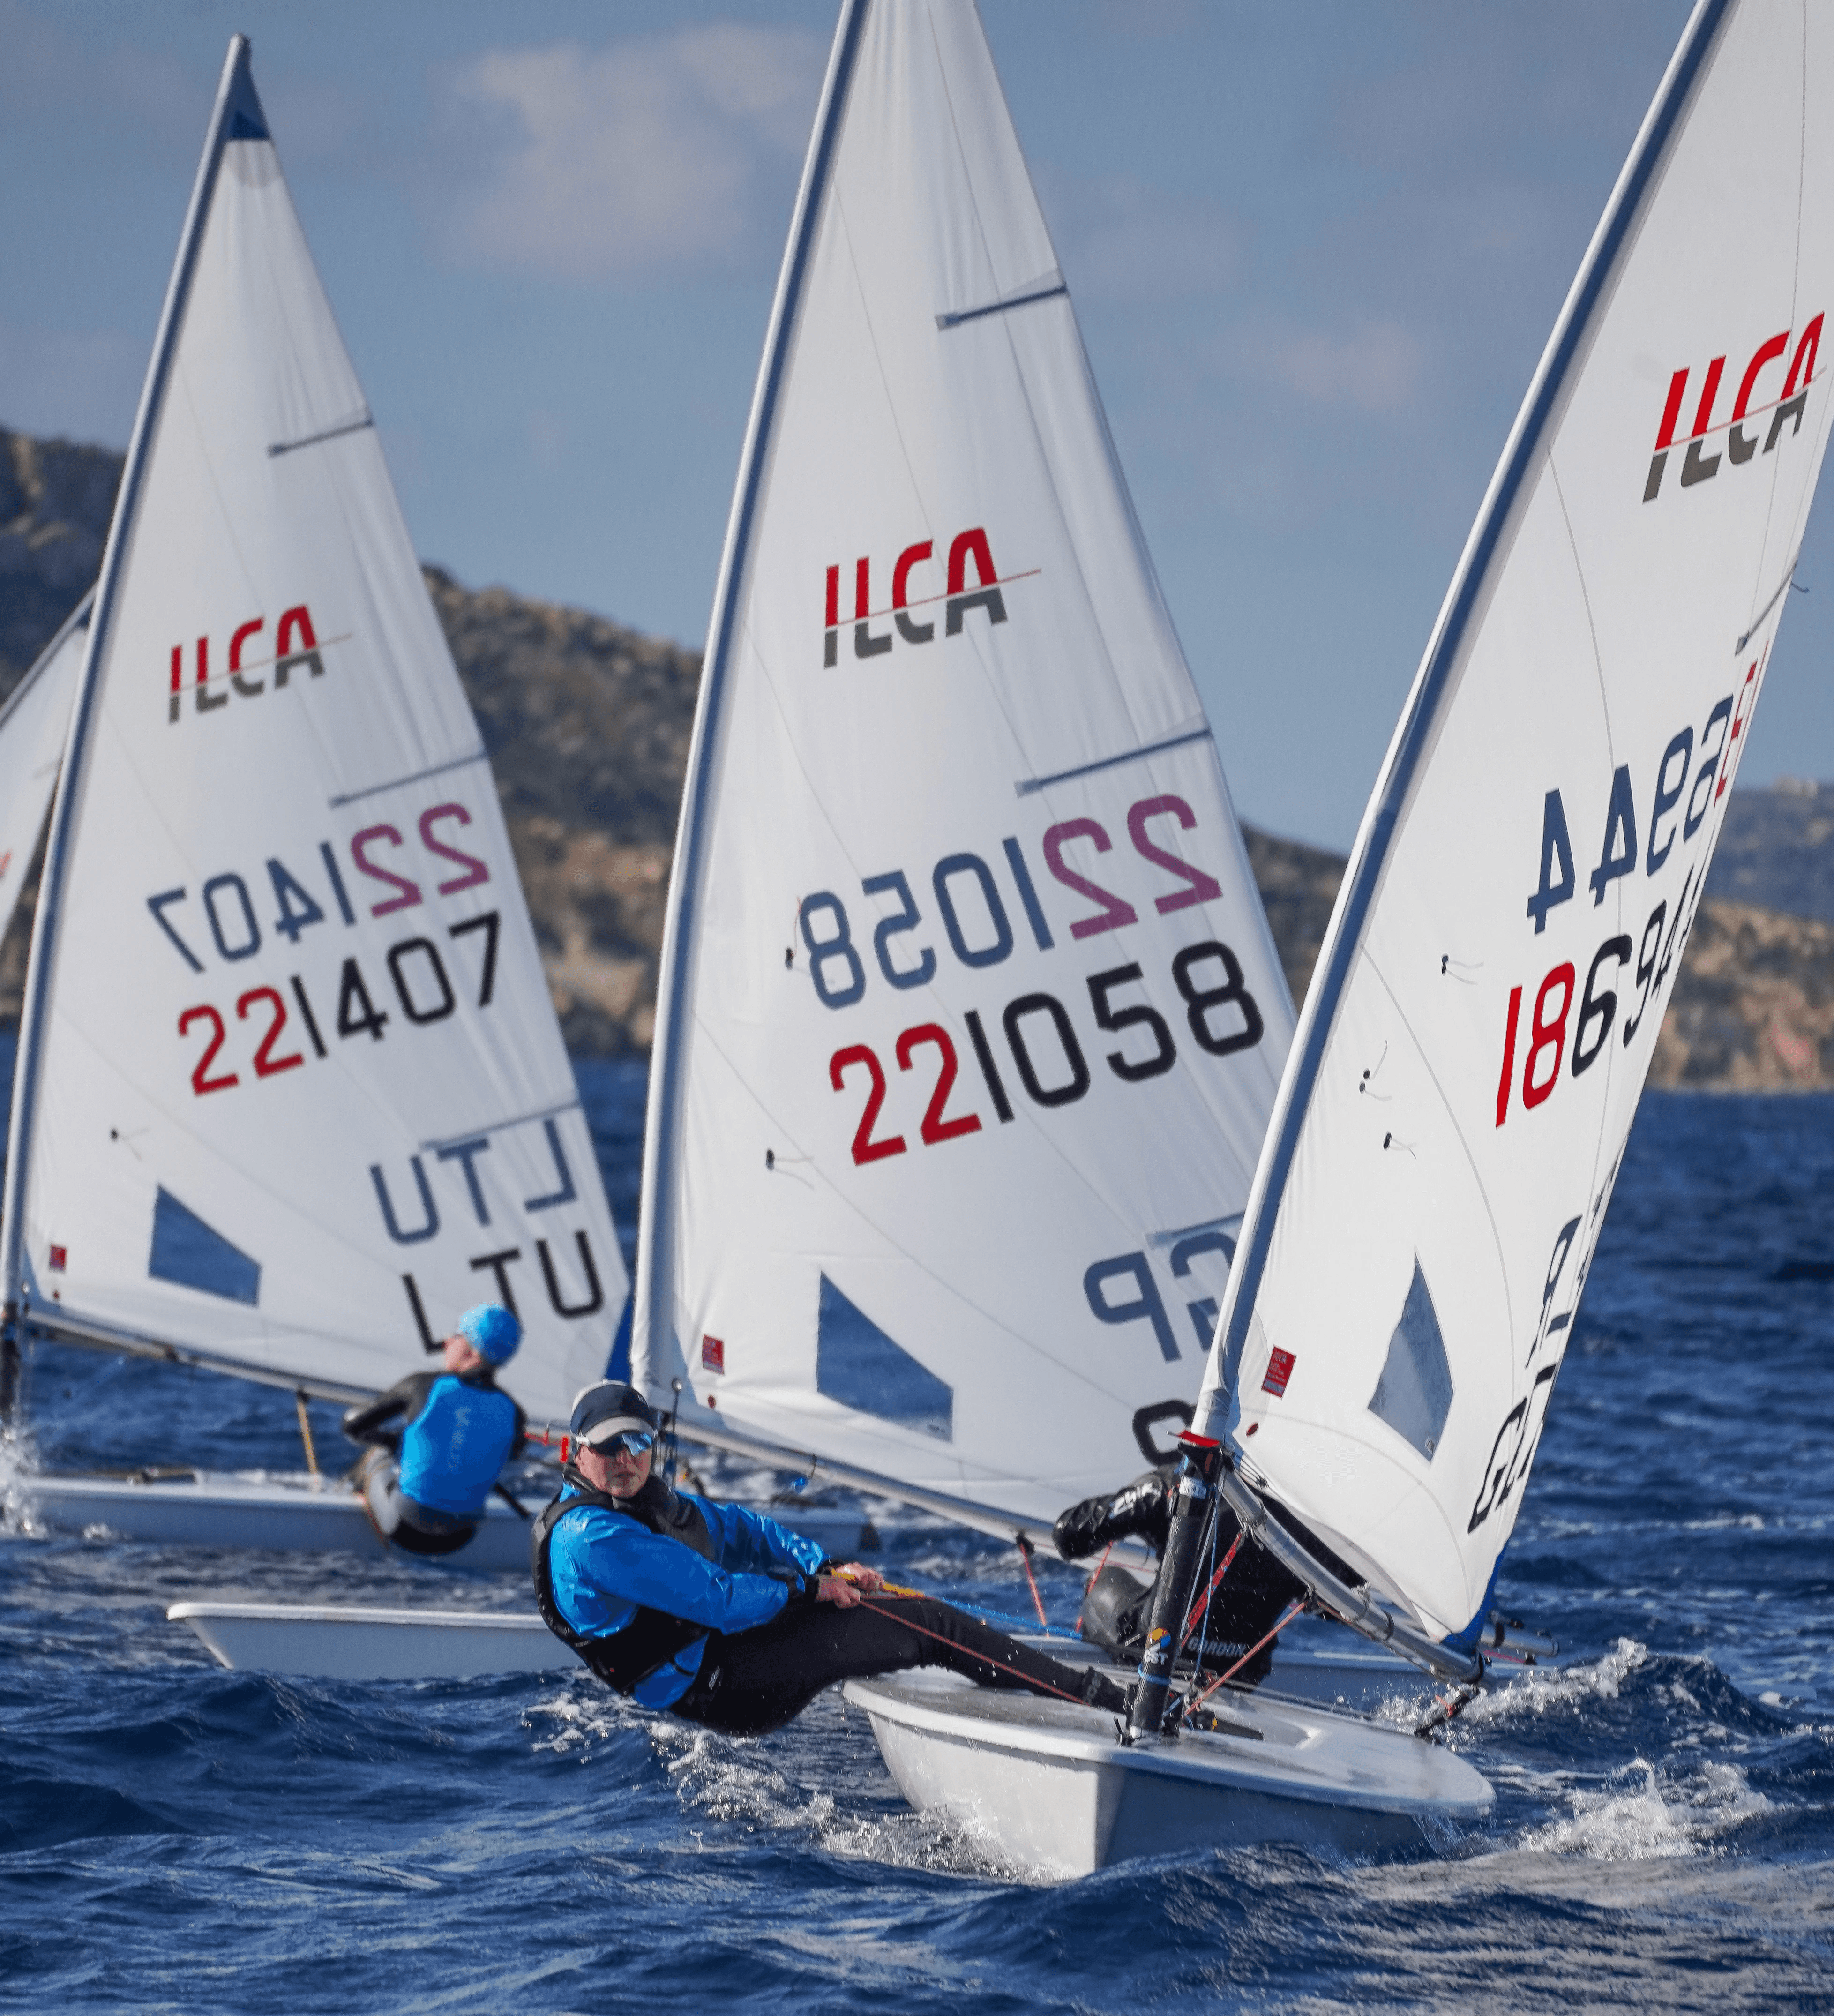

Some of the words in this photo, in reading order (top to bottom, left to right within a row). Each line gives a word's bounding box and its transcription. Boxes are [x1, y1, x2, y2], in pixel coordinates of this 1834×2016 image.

[1642, 310, 1825, 504] ILCA
[823, 526, 1008, 669] ILCA
[169, 605, 325, 725] ILCA
[178, 911, 500, 1096] 221407
[829, 940, 1264, 1167] 221058
[401, 1230, 604, 1354] LTU
[1144, 1649, 1168, 1665] CST
[1188, 1637, 1246, 1657] GORDON
